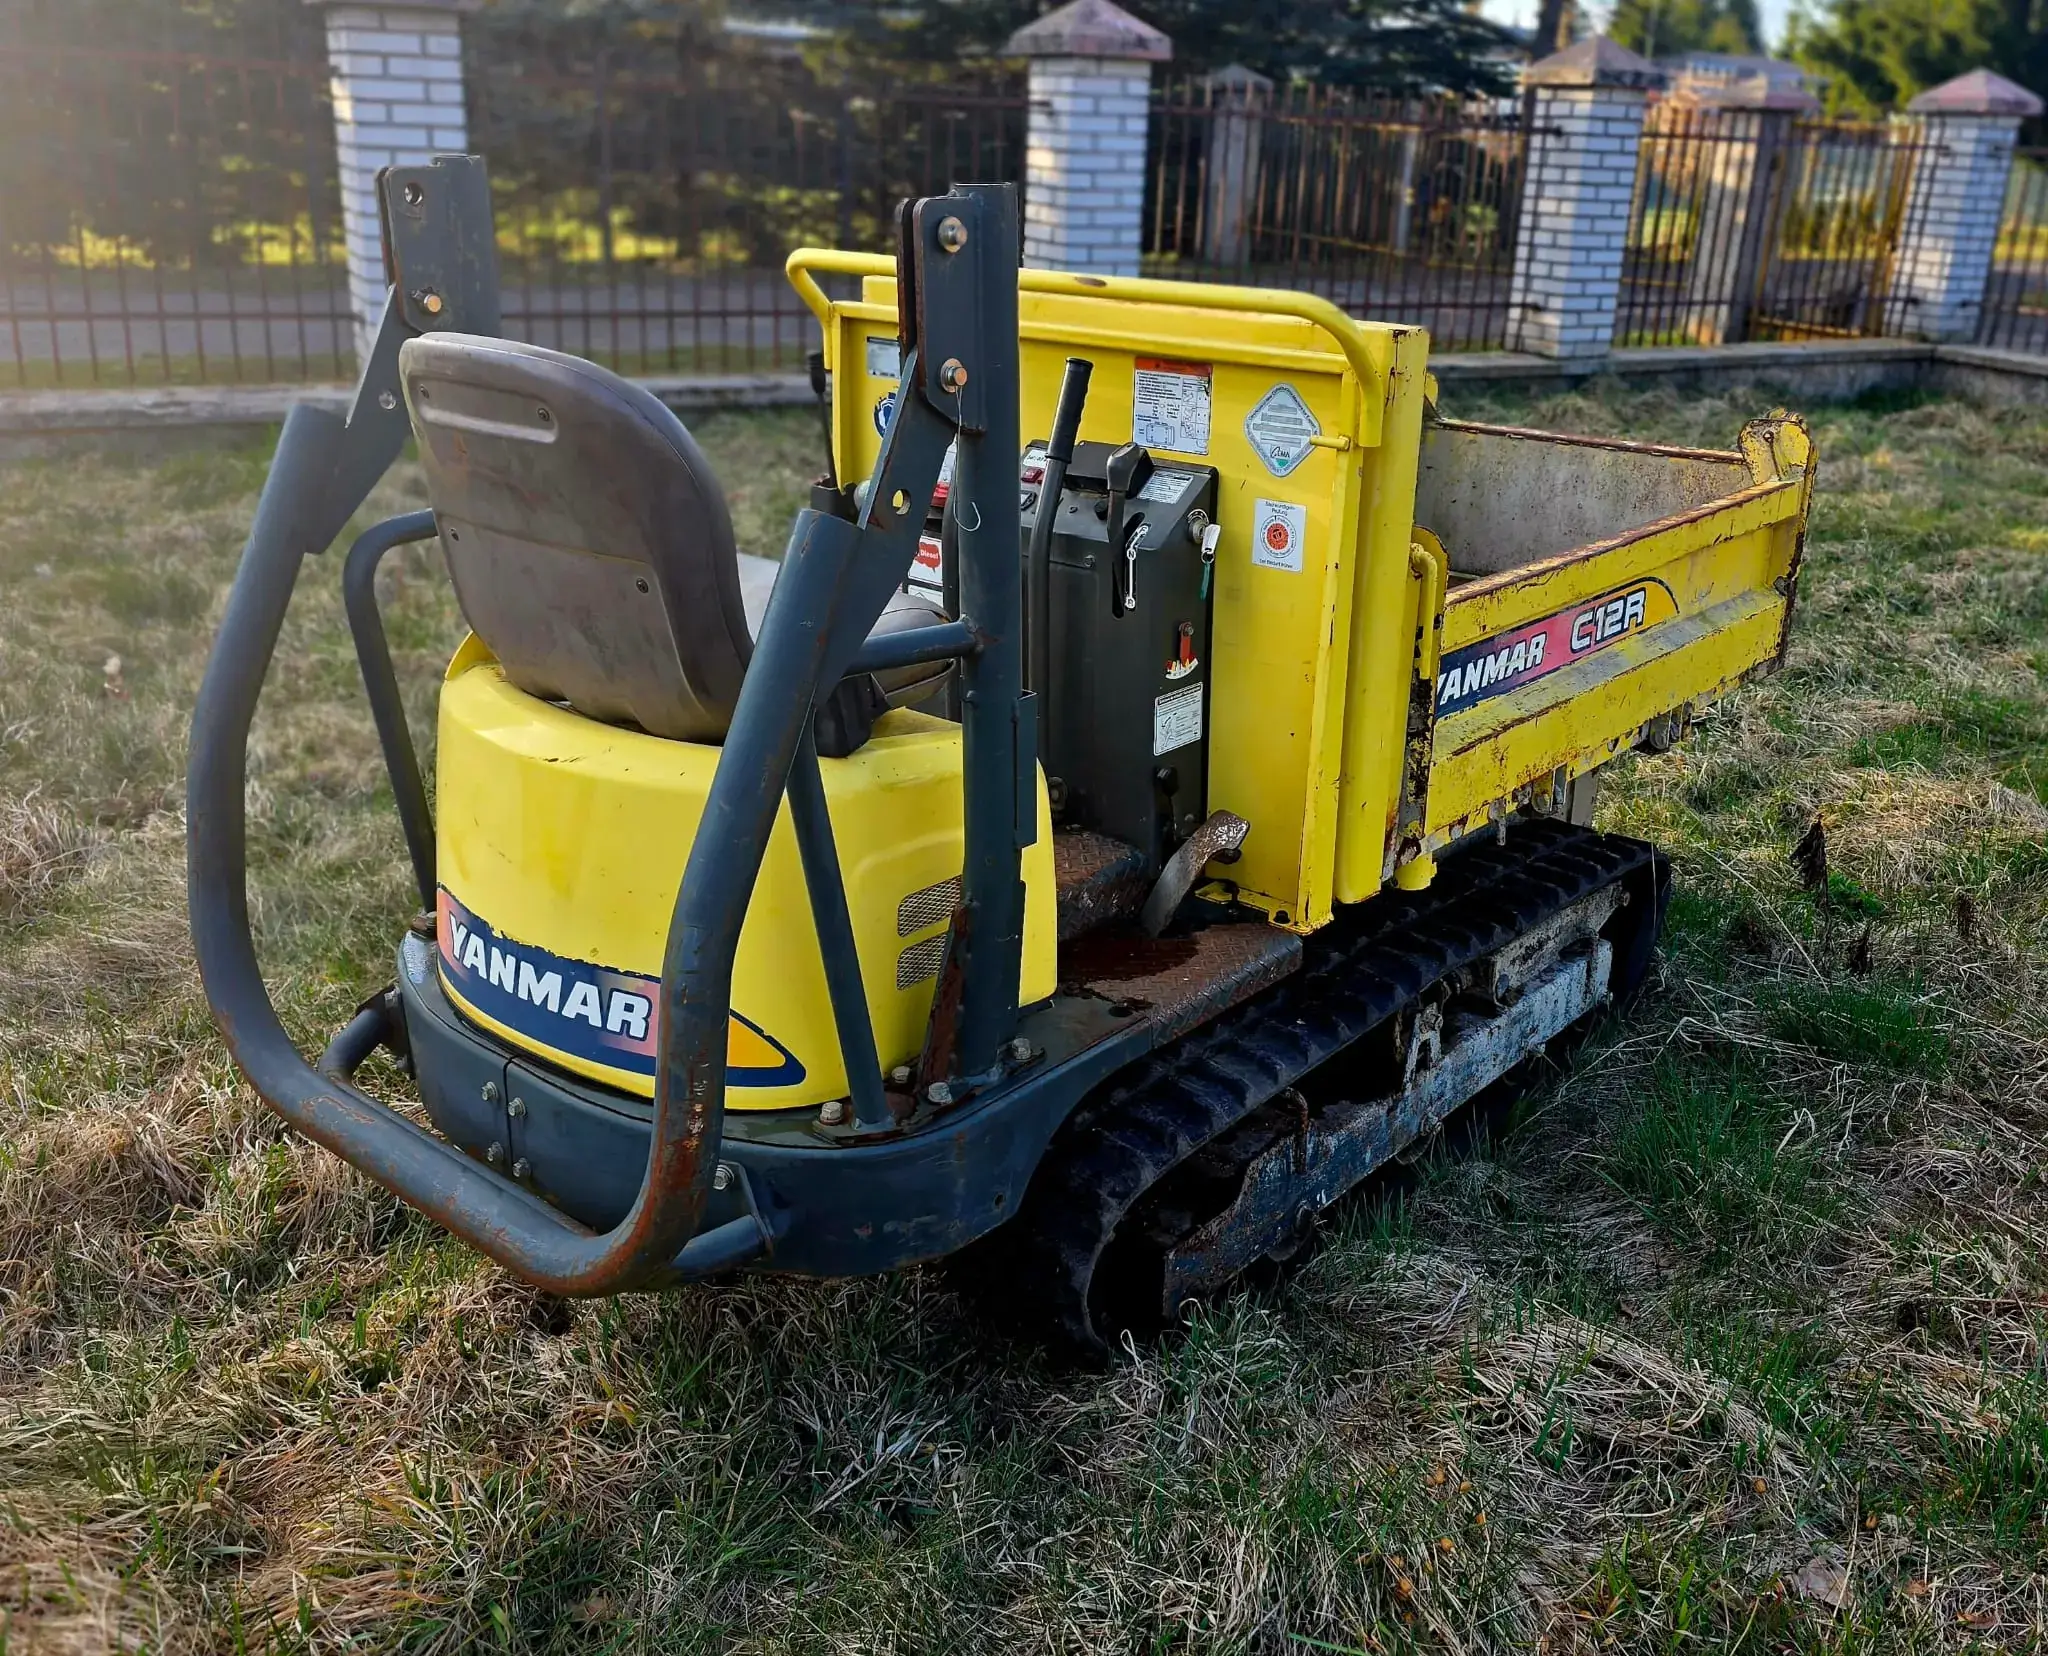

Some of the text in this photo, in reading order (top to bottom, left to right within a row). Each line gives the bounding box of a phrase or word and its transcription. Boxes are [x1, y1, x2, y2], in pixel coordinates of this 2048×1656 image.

[920, 549, 939, 559] Diesel
[1570, 589, 1646, 651] C12R
[448, 911, 652, 1038] YANMAR
